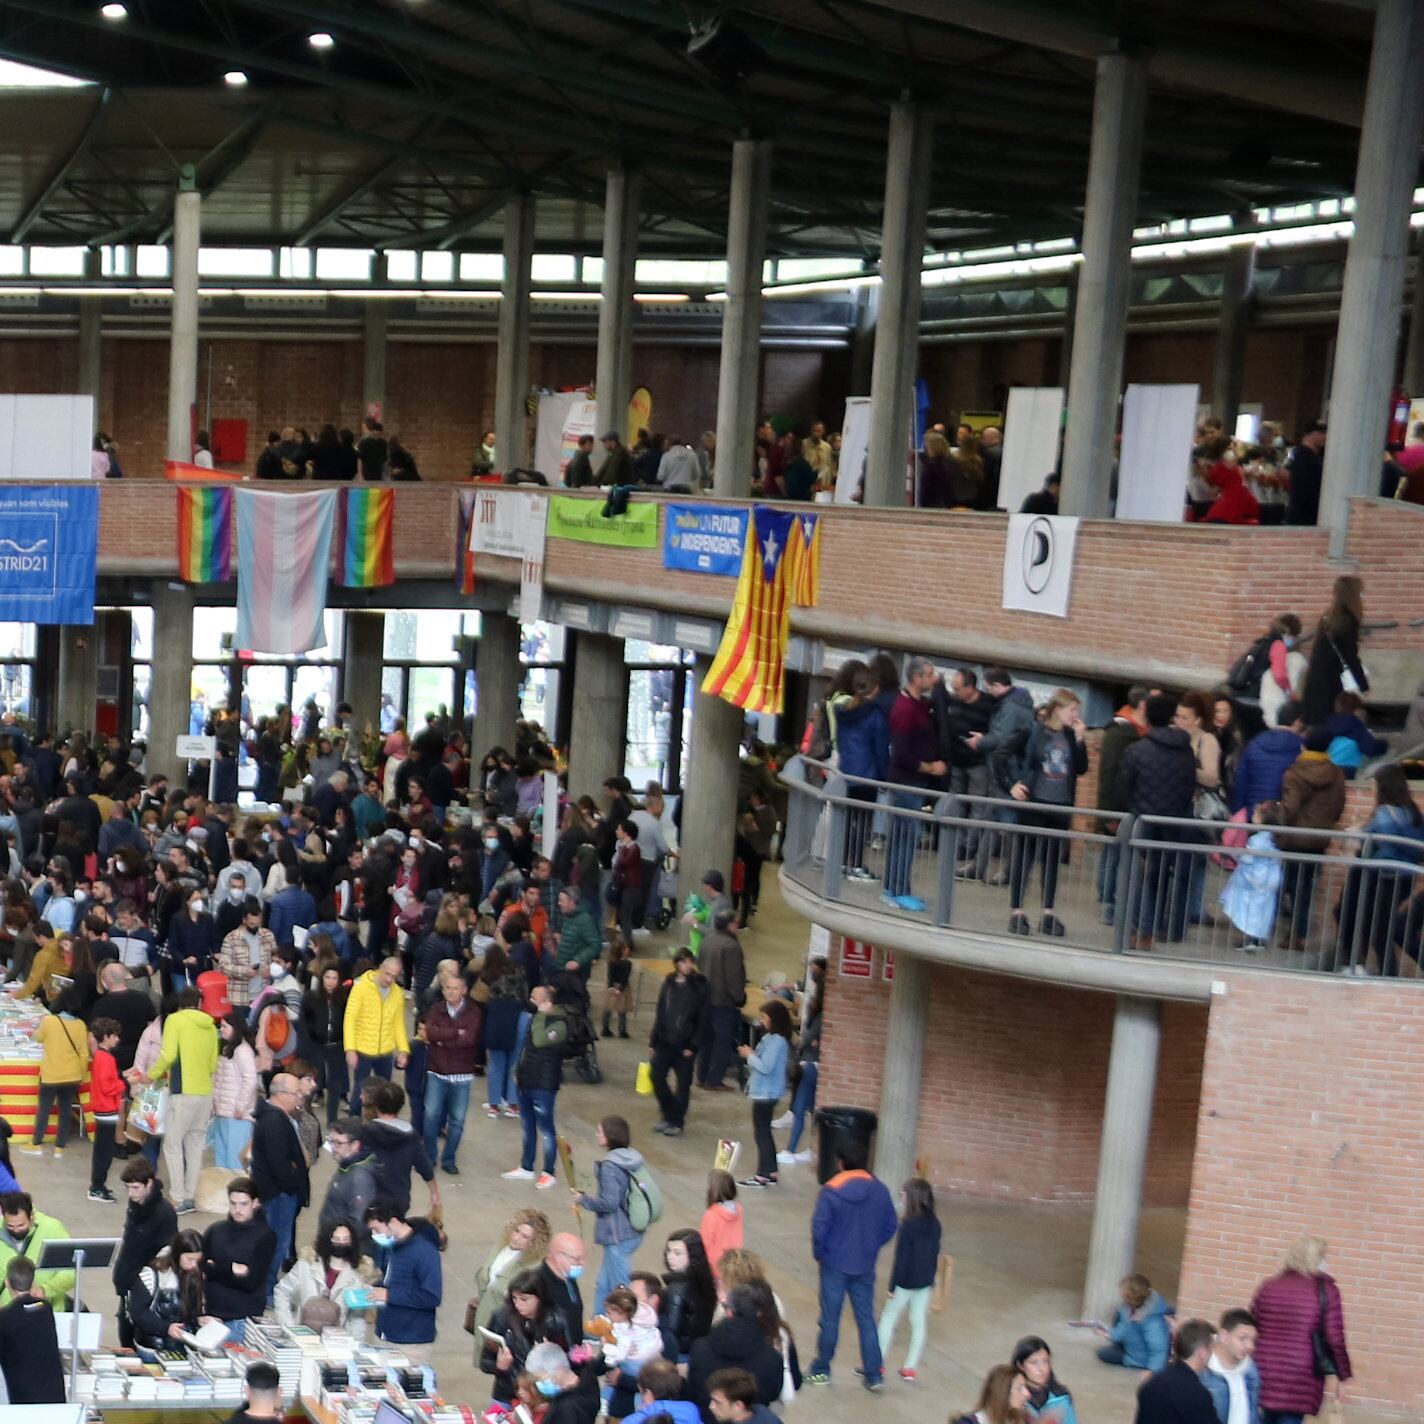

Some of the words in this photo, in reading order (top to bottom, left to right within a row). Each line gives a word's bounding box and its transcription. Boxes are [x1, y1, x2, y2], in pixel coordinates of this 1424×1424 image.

[18, 500, 37, 508] som
[38, 498, 69, 508] visibles
[711, 513, 740, 534] FUTUR
